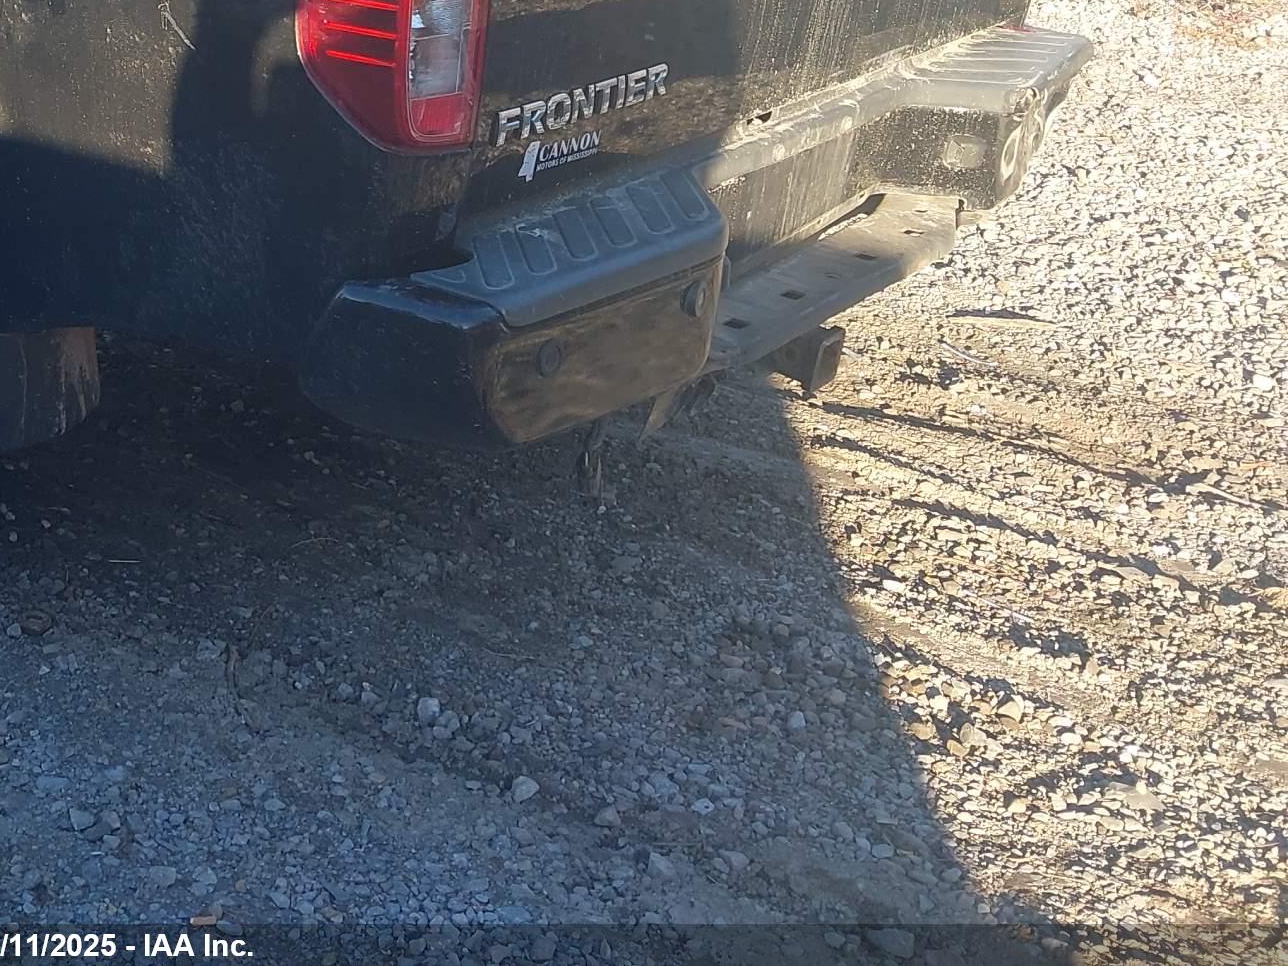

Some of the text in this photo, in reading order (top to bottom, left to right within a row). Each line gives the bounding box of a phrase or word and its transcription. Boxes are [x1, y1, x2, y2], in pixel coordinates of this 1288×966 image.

[495, 63, 669, 147] FRONTIER
[539, 129, 602, 162] CANNON
[536, 159, 559, 172] MOTORS
[559, 156, 568, 165] OF
